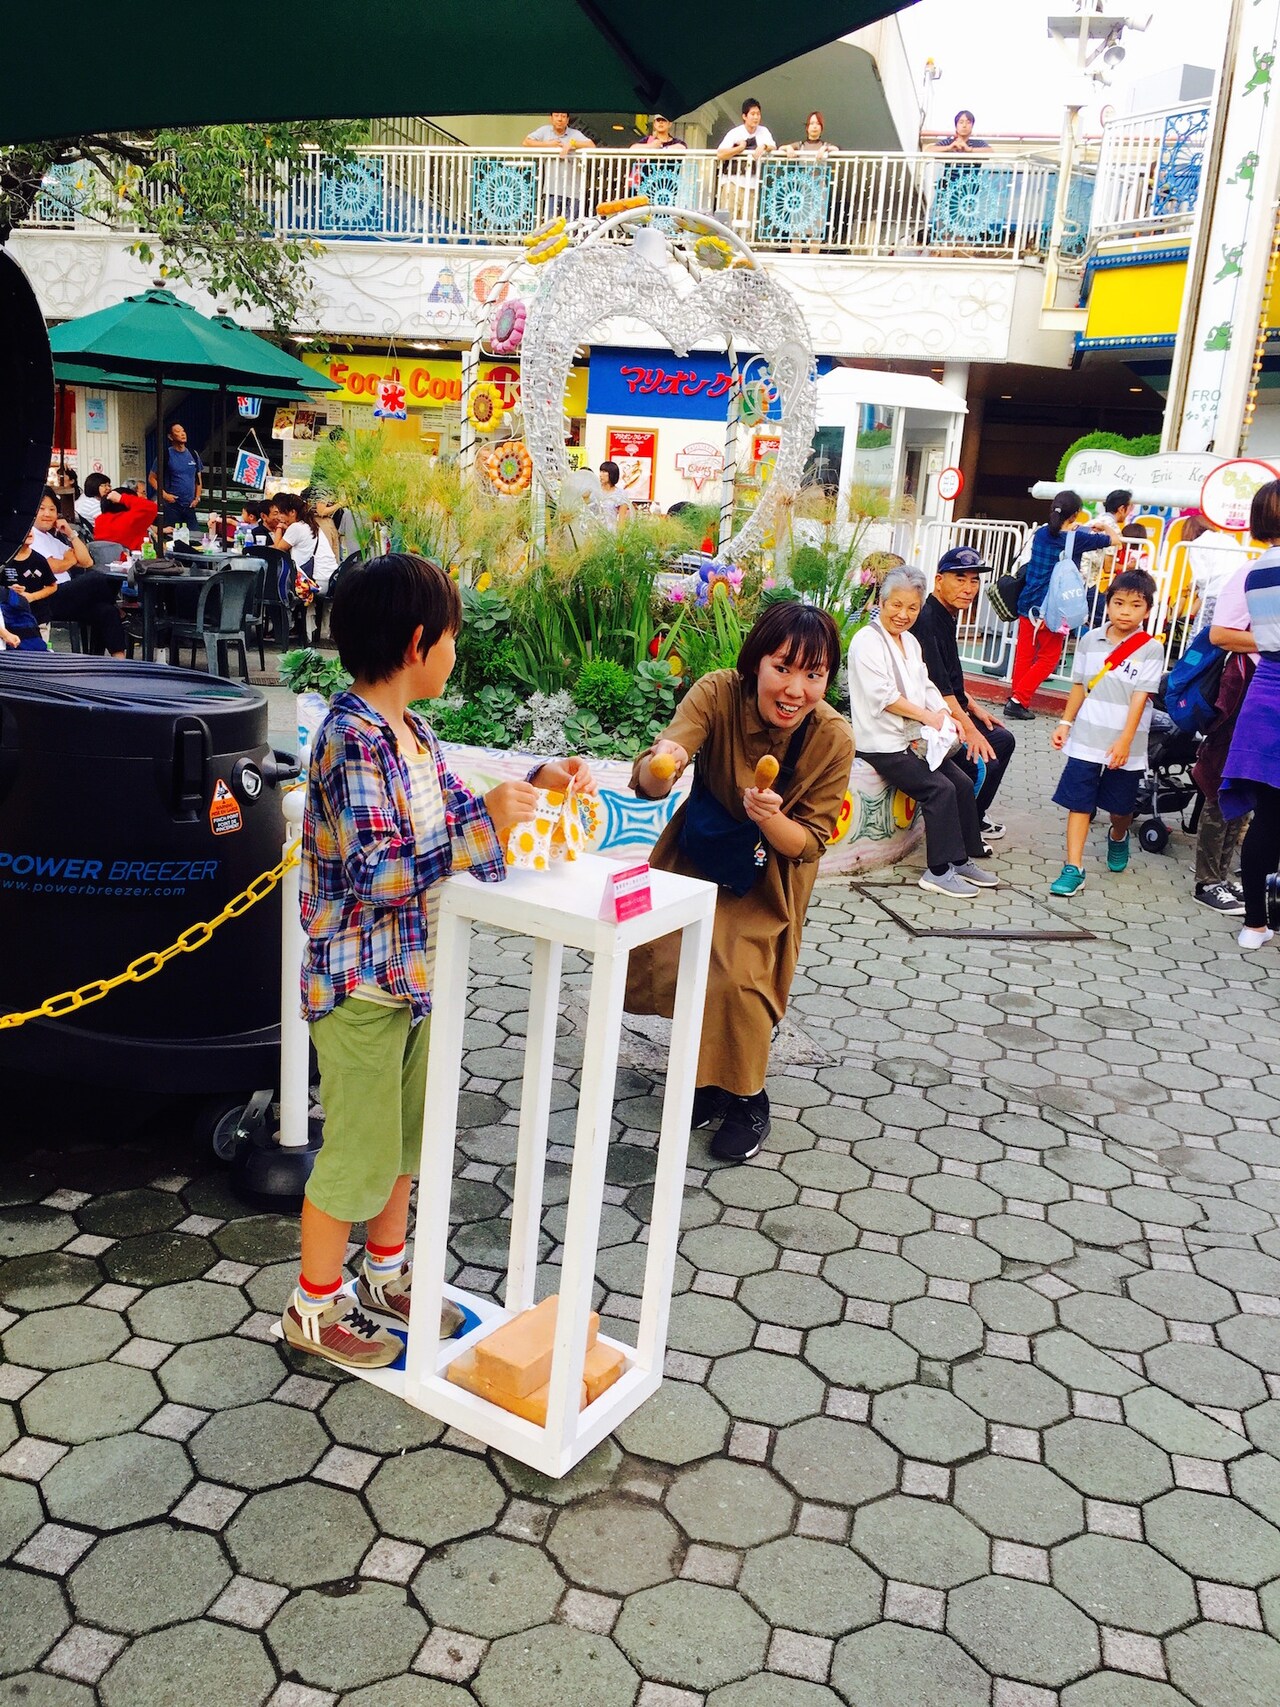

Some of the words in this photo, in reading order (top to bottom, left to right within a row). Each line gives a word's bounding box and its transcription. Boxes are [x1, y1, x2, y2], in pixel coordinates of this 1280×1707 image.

[409, 367, 462, 401] Cou
[620, 365, 743, 398] マリオンク
[1078, 460, 1103, 476] Andy
[1114, 464, 1136, 485] Lexi
[1151, 468, 1173, 484] Eric
[1061, 587, 1084, 601] NYC
[0, 852, 103, 879] POWER
[108, 860, 219, 881] BREEZER
[0, 879, 186, 897] ww.powerbreezer.com
